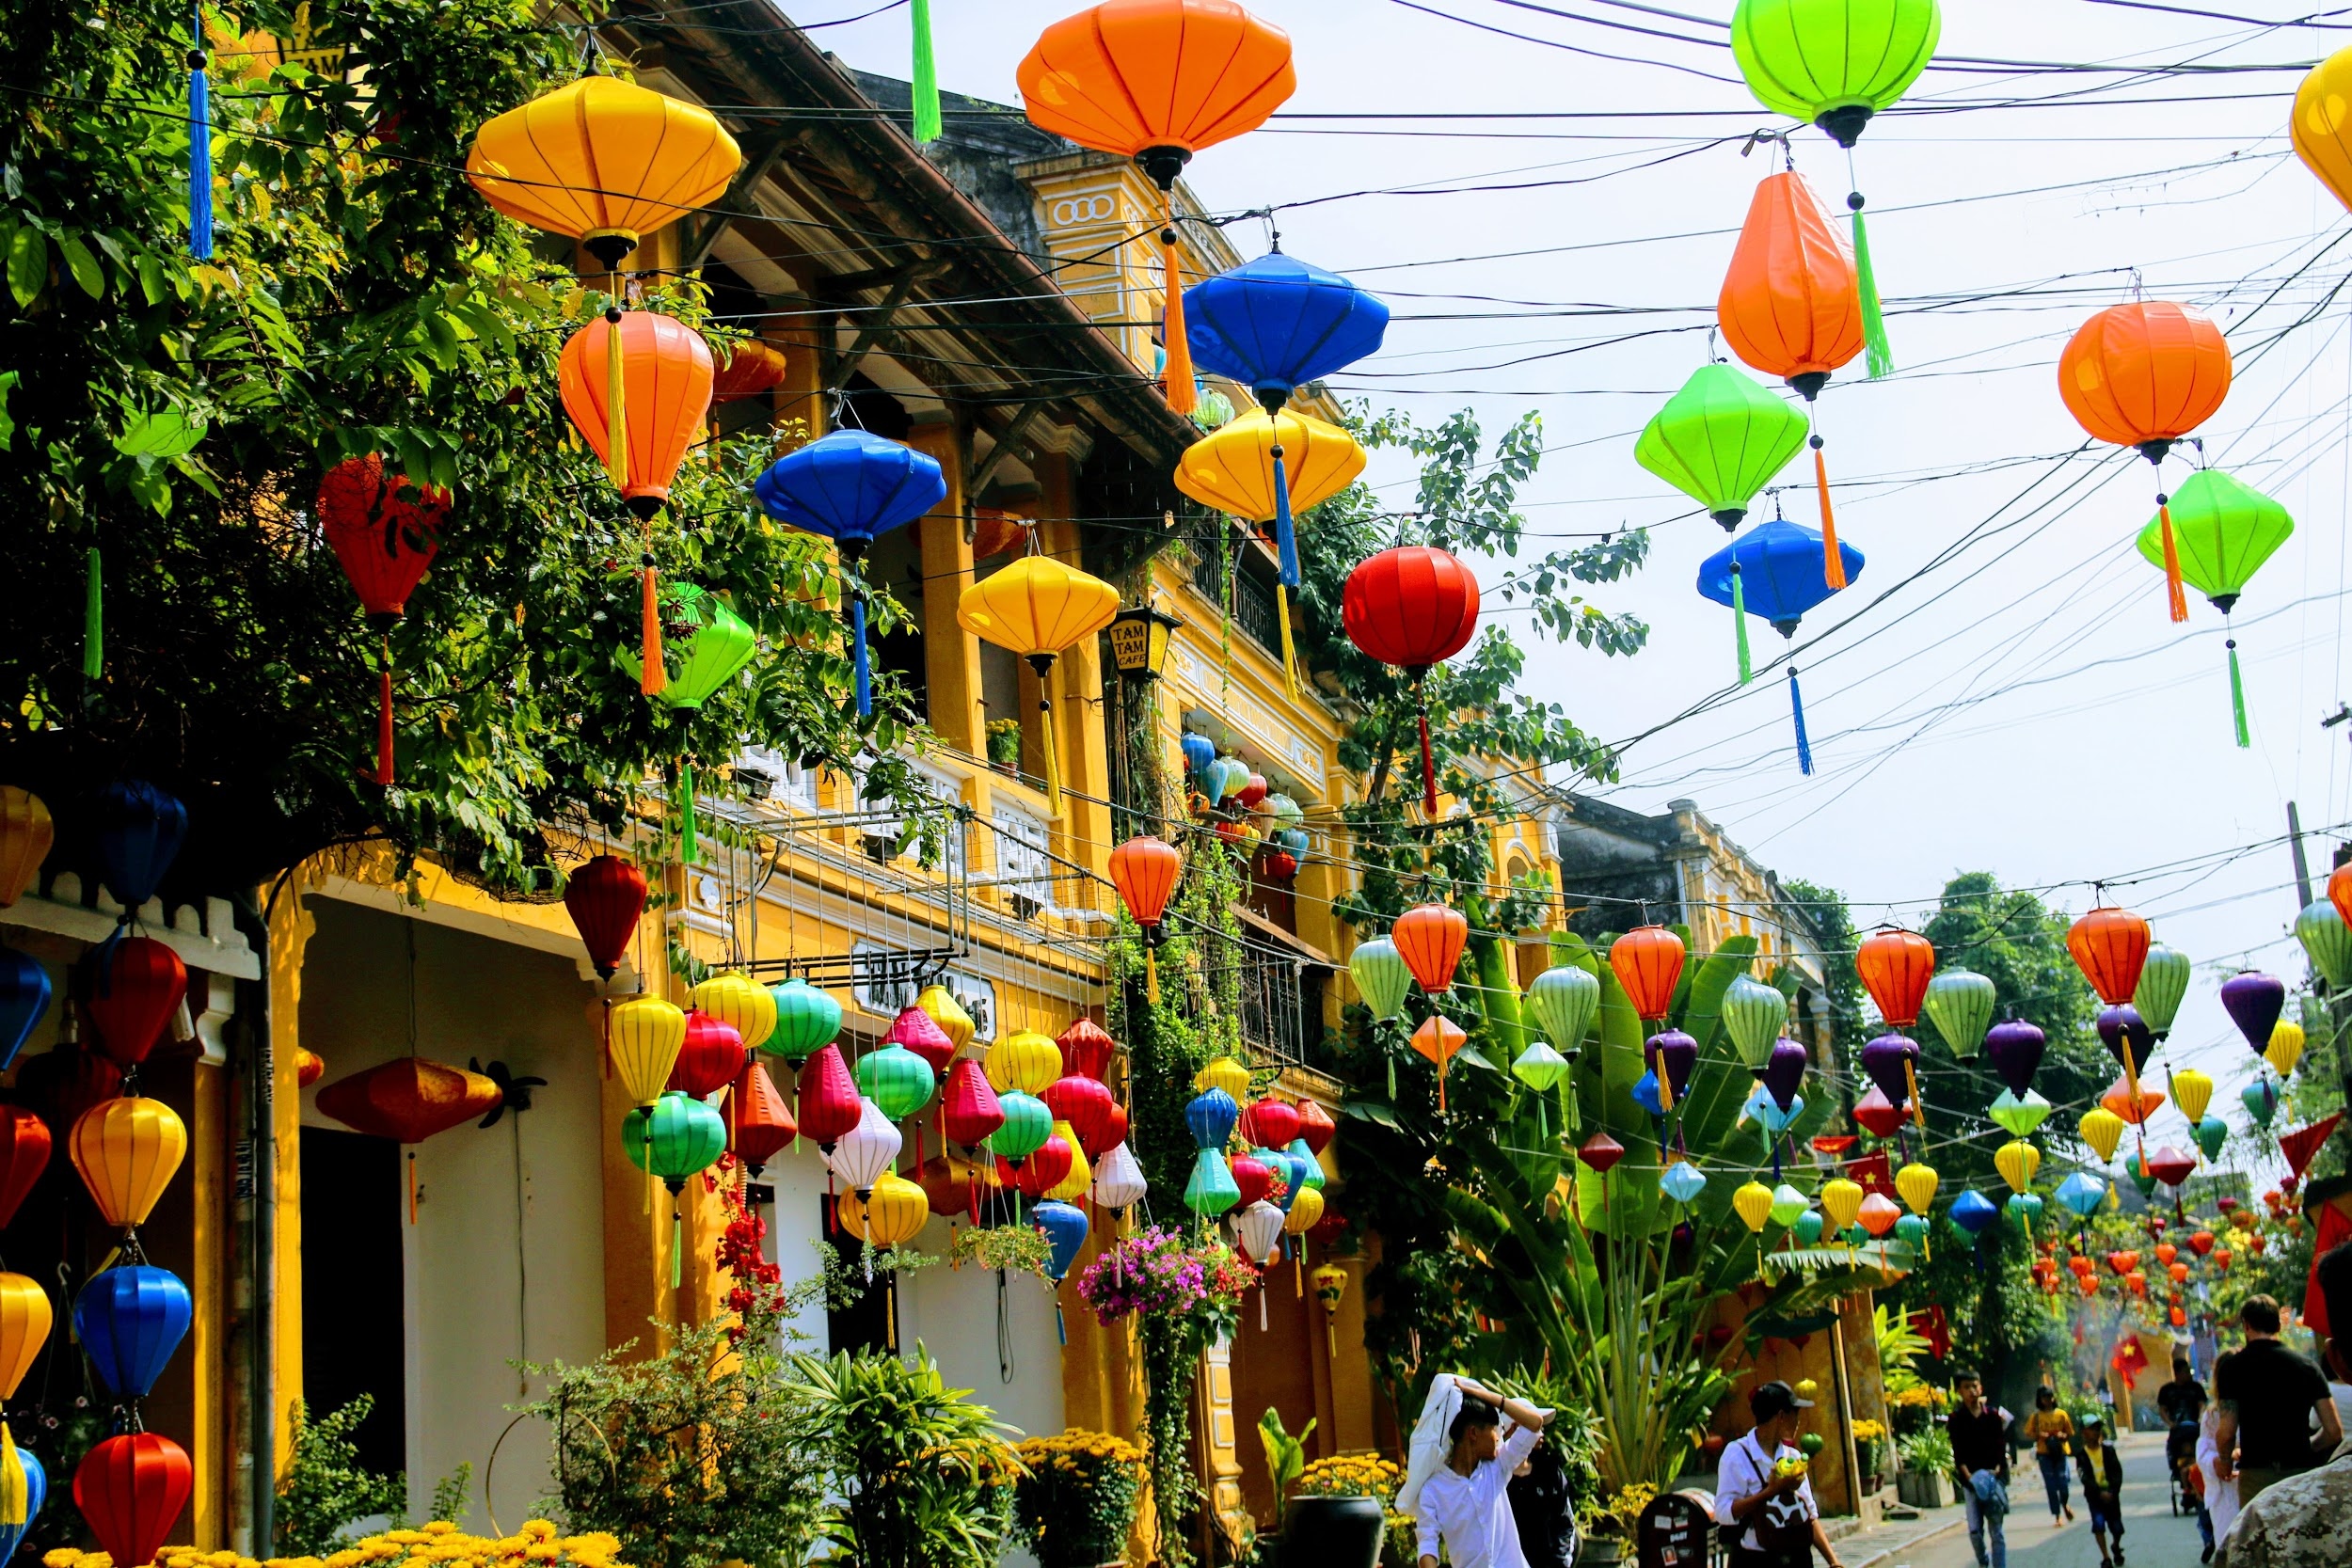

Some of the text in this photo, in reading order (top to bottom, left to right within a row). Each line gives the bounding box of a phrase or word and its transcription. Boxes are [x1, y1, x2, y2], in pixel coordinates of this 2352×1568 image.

[1113, 625, 1144, 641] TAM
[1115, 641, 1144, 655] TAM
[1119, 654, 1146, 666] CAFE
